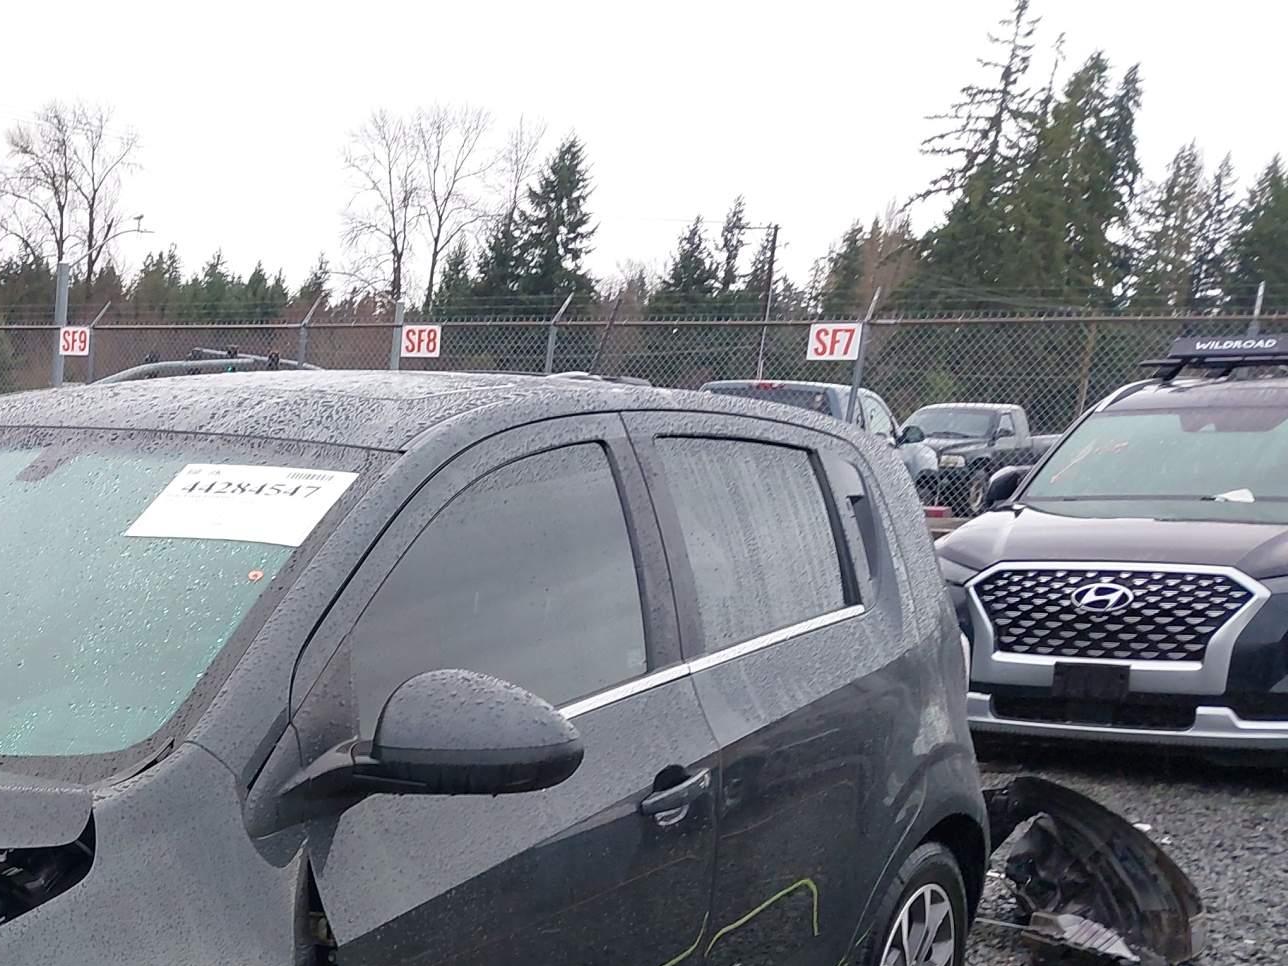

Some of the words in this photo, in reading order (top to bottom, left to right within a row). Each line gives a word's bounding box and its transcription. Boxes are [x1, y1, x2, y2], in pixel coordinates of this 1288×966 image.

[62, 330, 87, 352] SF9
[405, 329, 437, 353] SF8
[813, 328, 855, 356] SF7
[1195, 338, 1277, 351] WILDROAD
[181, 480, 321, 498] 44284547
